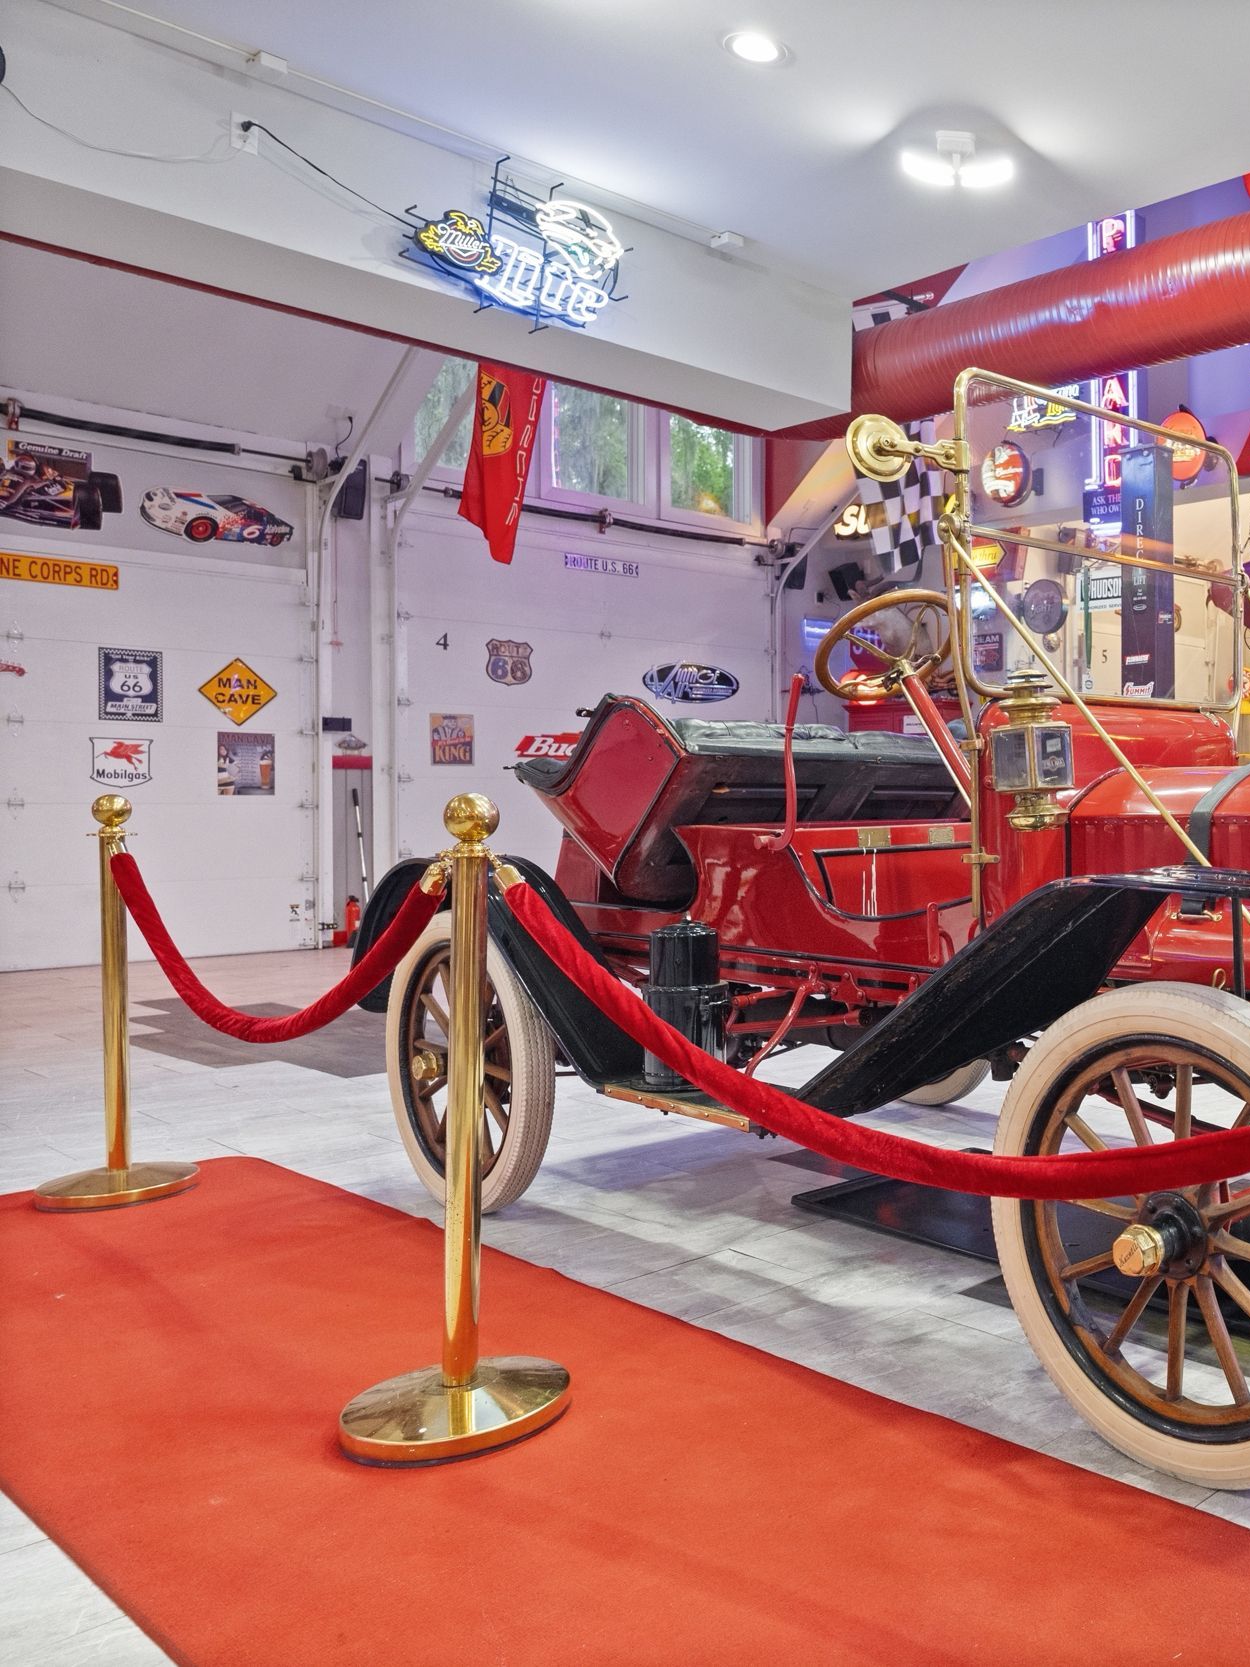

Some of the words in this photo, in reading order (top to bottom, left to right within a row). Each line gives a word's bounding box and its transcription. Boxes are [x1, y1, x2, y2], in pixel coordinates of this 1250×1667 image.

[437, 223, 491, 252] Miller
[19, 442, 59, 455] Genuine
[62, 449, 87, 460] Draft
[1092, 495, 1105, 506] ASK
[1091, 506, 1107, 515] WHO
[243, 525, 263, 538] 6
[0, 556, 21, 577] NE
[29, 560, 83, 583] CORPS
[89, 567, 114, 587] RD.
[568, 555, 599, 570] ROUTE
[602, 560, 620, 574] U.S.
[622, 562, 635, 575] 66
[435, 632, 449, 650] 4
[1101, 649, 1108, 664] 5
[118, 664, 144, 673] ROUTE
[490, 657, 528, 681] 66
[120, 680, 143, 693] 66
[217, 677, 258, 690] MAN
[1125, 683, 1154, 696] SUMMIT
[214, 692, 262, 705] CAVE
[221, 734, 245, 744] MAN
[434, 744, 470, 762] KING
[96, 769, 148, 782] Mobilgas
